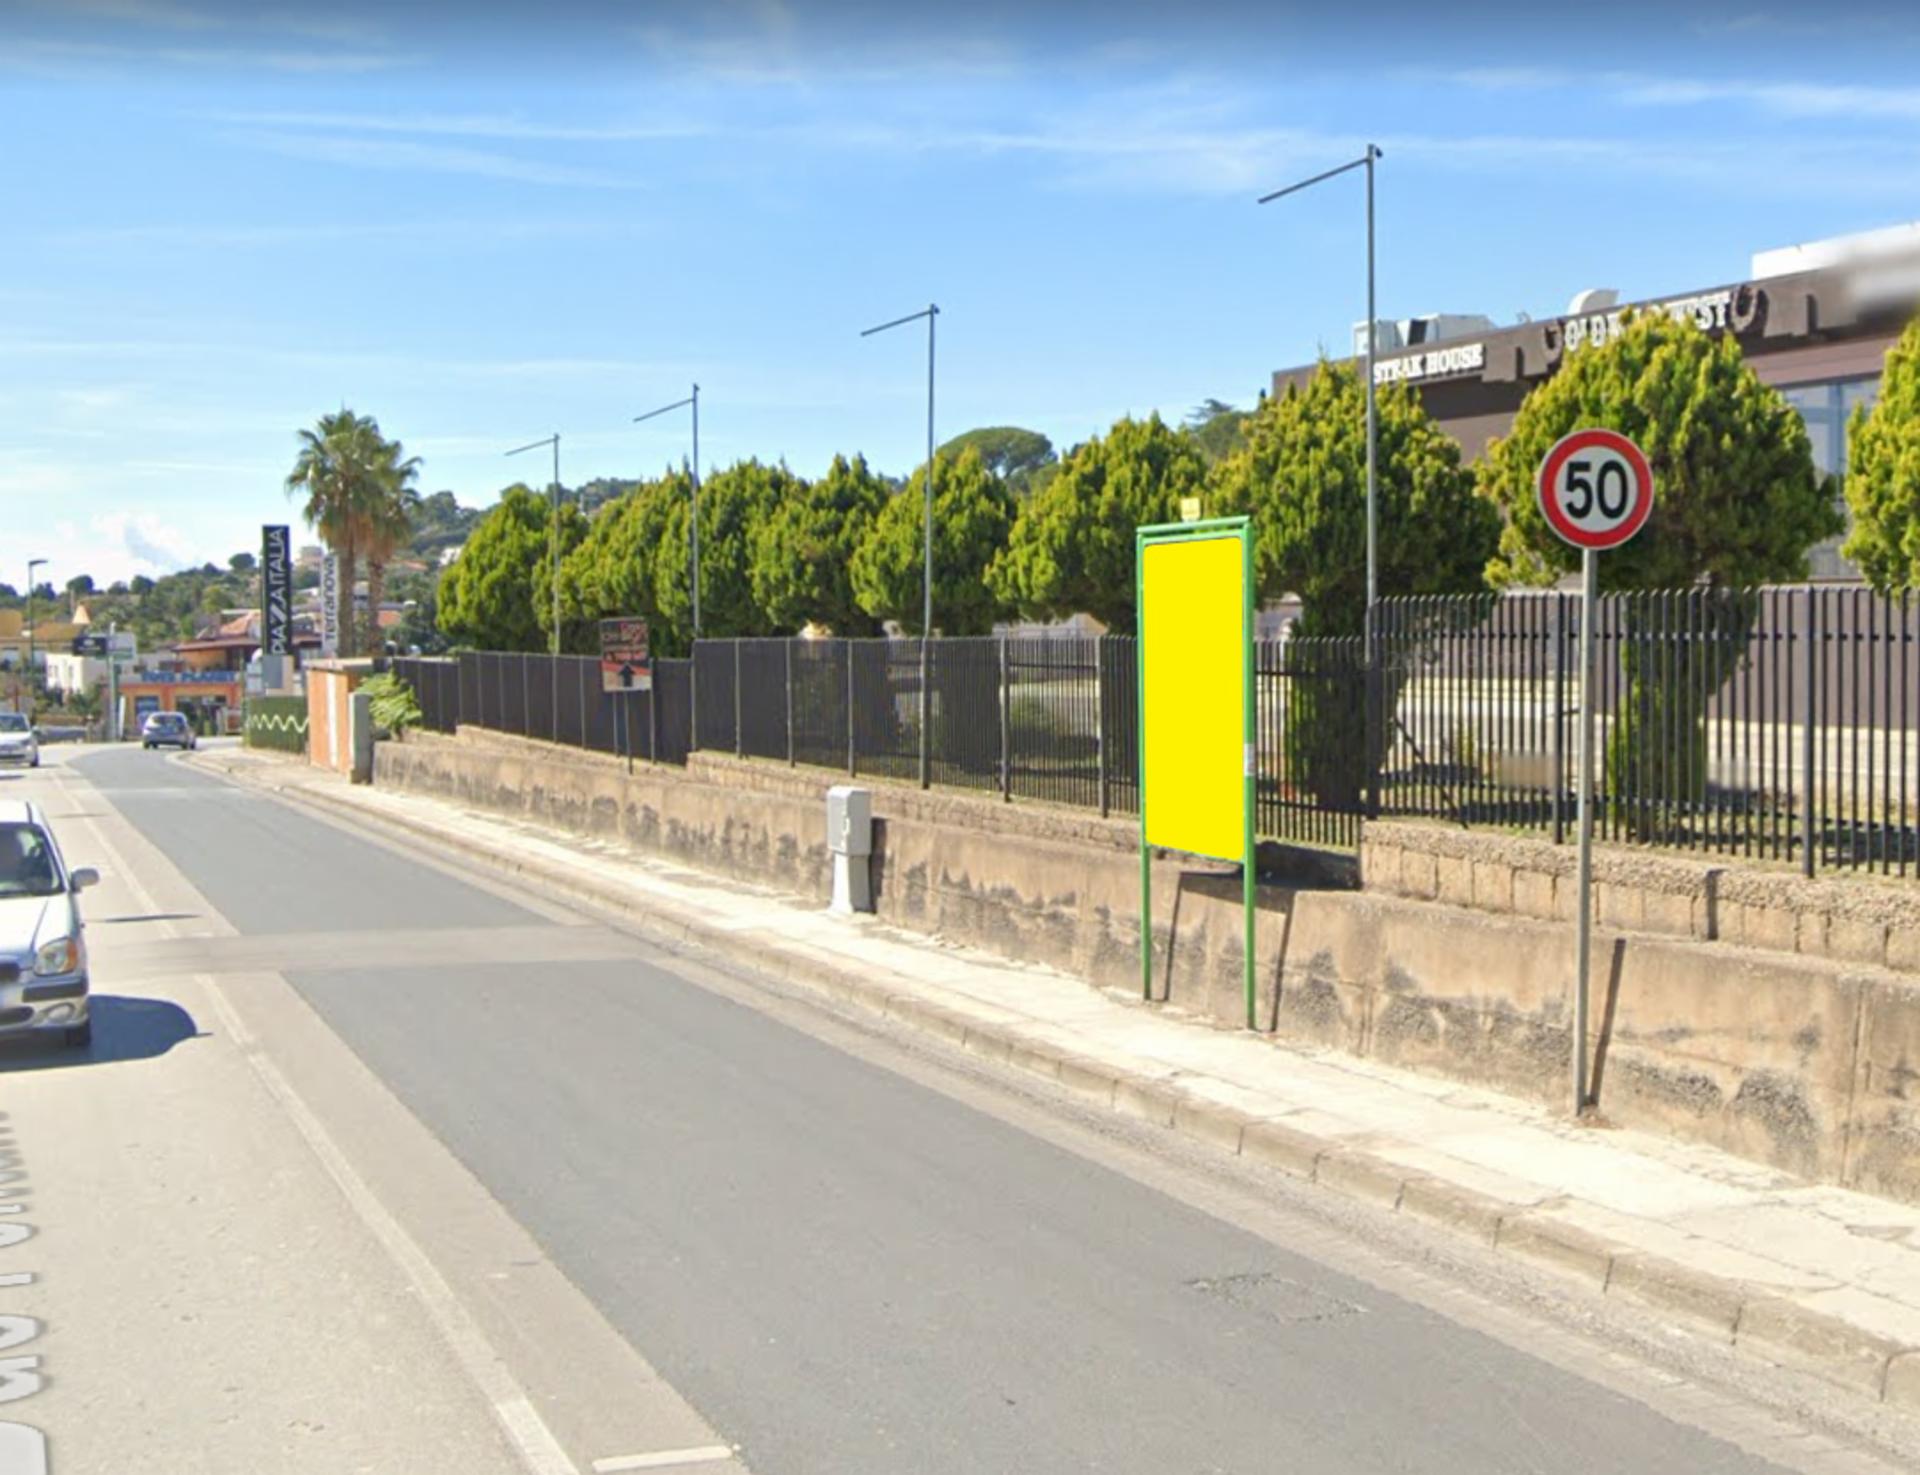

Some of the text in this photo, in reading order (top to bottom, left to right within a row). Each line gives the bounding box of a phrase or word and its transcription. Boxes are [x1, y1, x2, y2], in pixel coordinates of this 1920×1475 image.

[1374, 343, 1483, 384] STEAK HOUSE
[1565, 460, 1628, 519] 50
